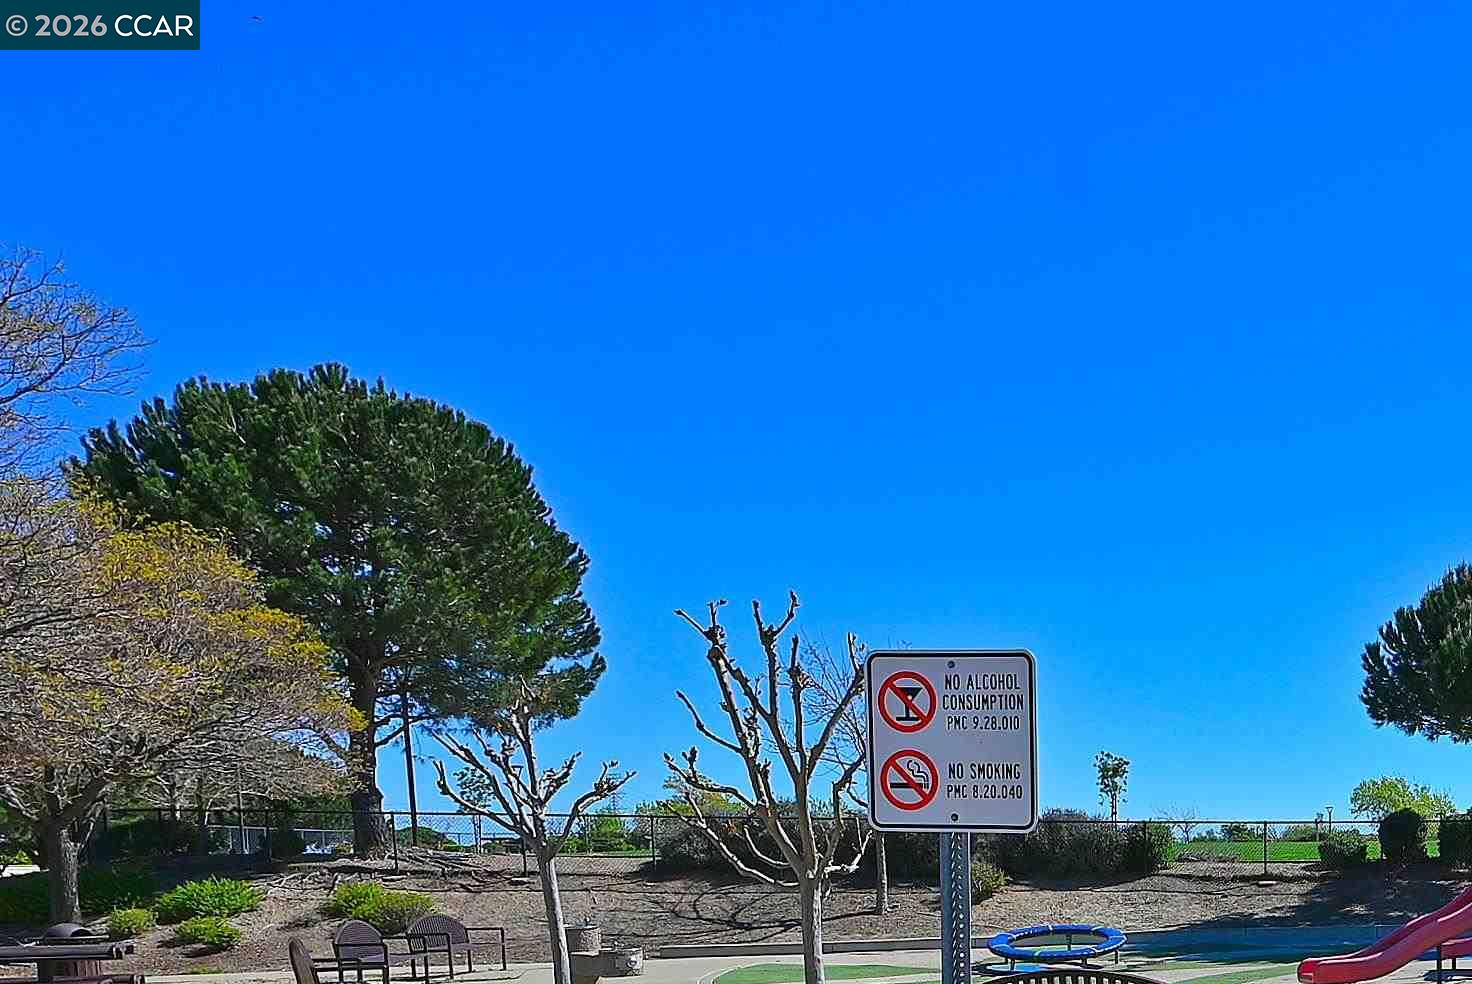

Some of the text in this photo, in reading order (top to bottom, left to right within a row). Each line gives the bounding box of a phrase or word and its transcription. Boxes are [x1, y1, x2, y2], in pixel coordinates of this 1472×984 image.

[944, 674, 1021, 691] NO ALCOHOL
[942, 694, 1024, 711] CONSUMPTION
[947, 716, 1020, 730] PMC 9.28.010
[948, 763, 1021, 779] NO SMOKING
[947, 785, 1022, 799] PMC 8.20.040
